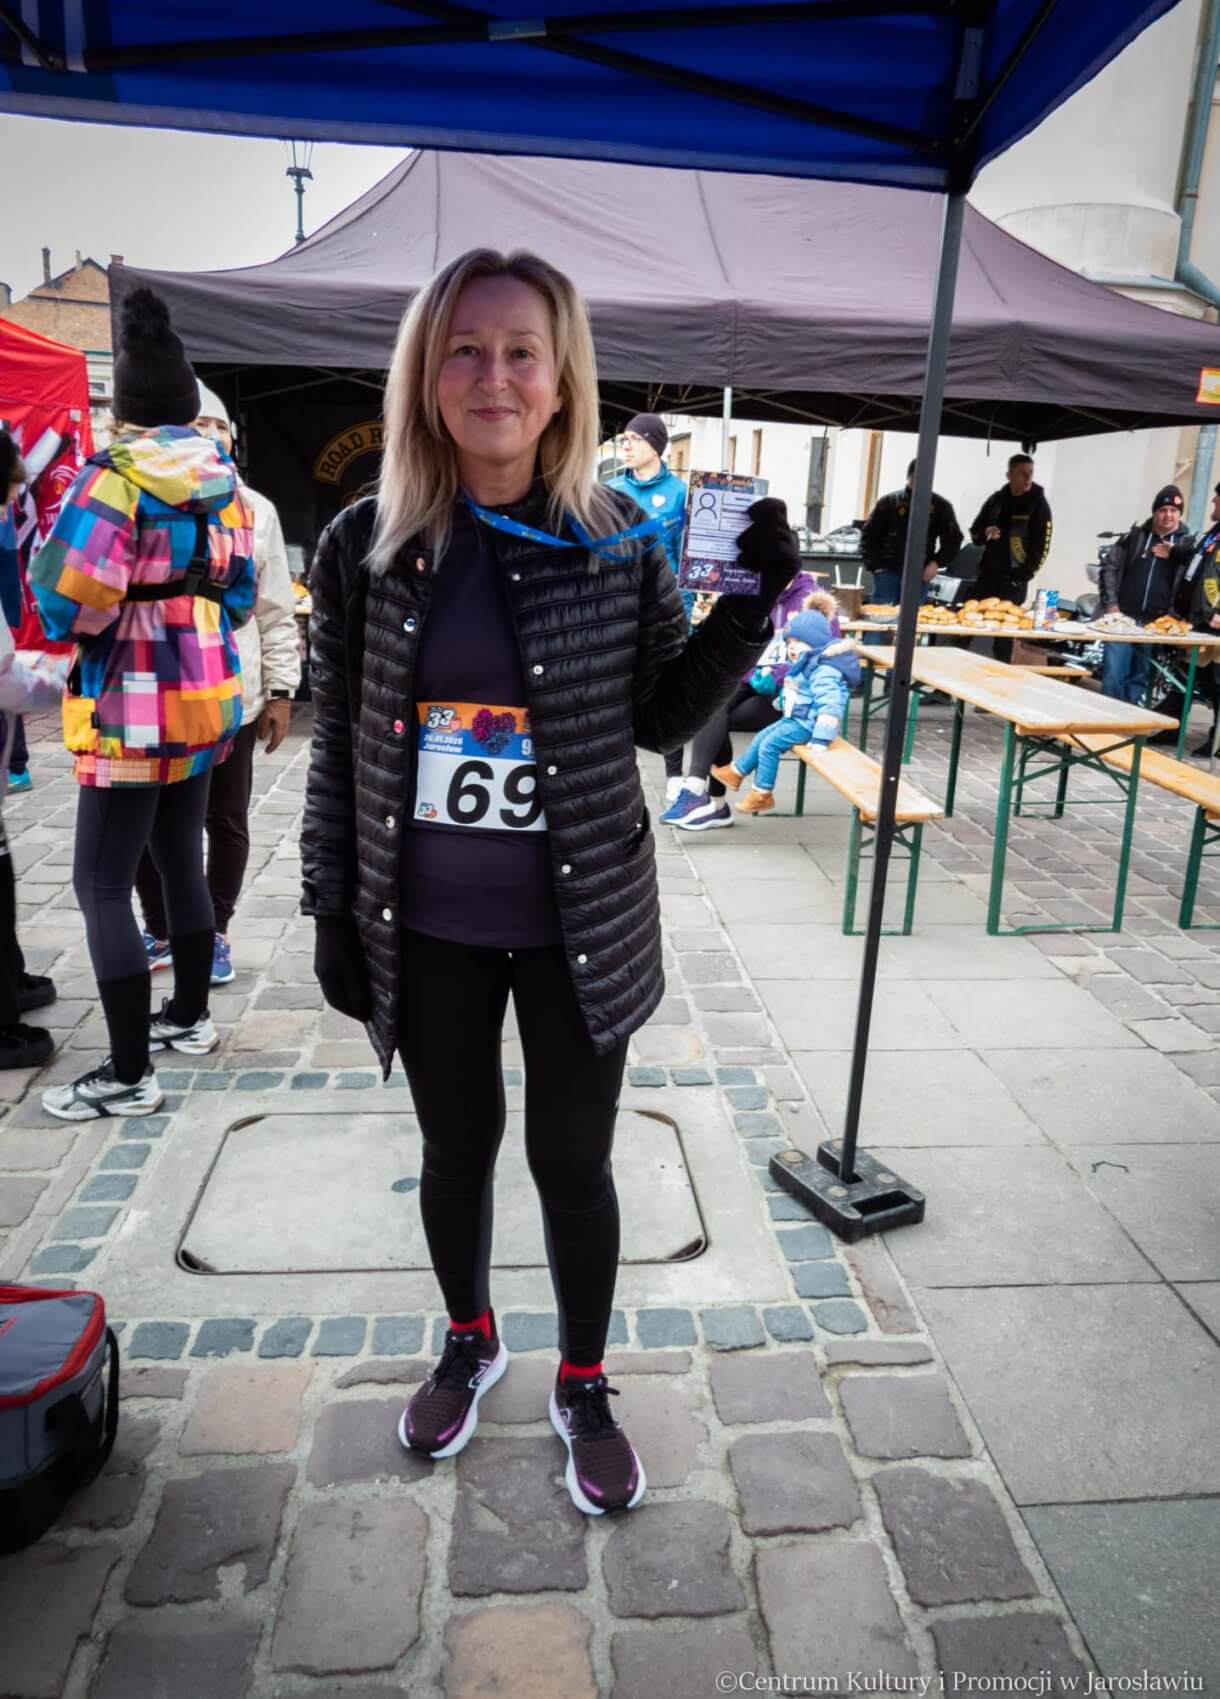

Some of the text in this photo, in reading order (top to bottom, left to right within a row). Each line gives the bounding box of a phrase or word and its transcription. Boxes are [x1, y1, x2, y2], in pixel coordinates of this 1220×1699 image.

[320, 432, 364, 479] ROAD
[688, 564, 714, 579] 33
[428, 709, 454, 729] 33
[446, 760, 543, 829] 69
